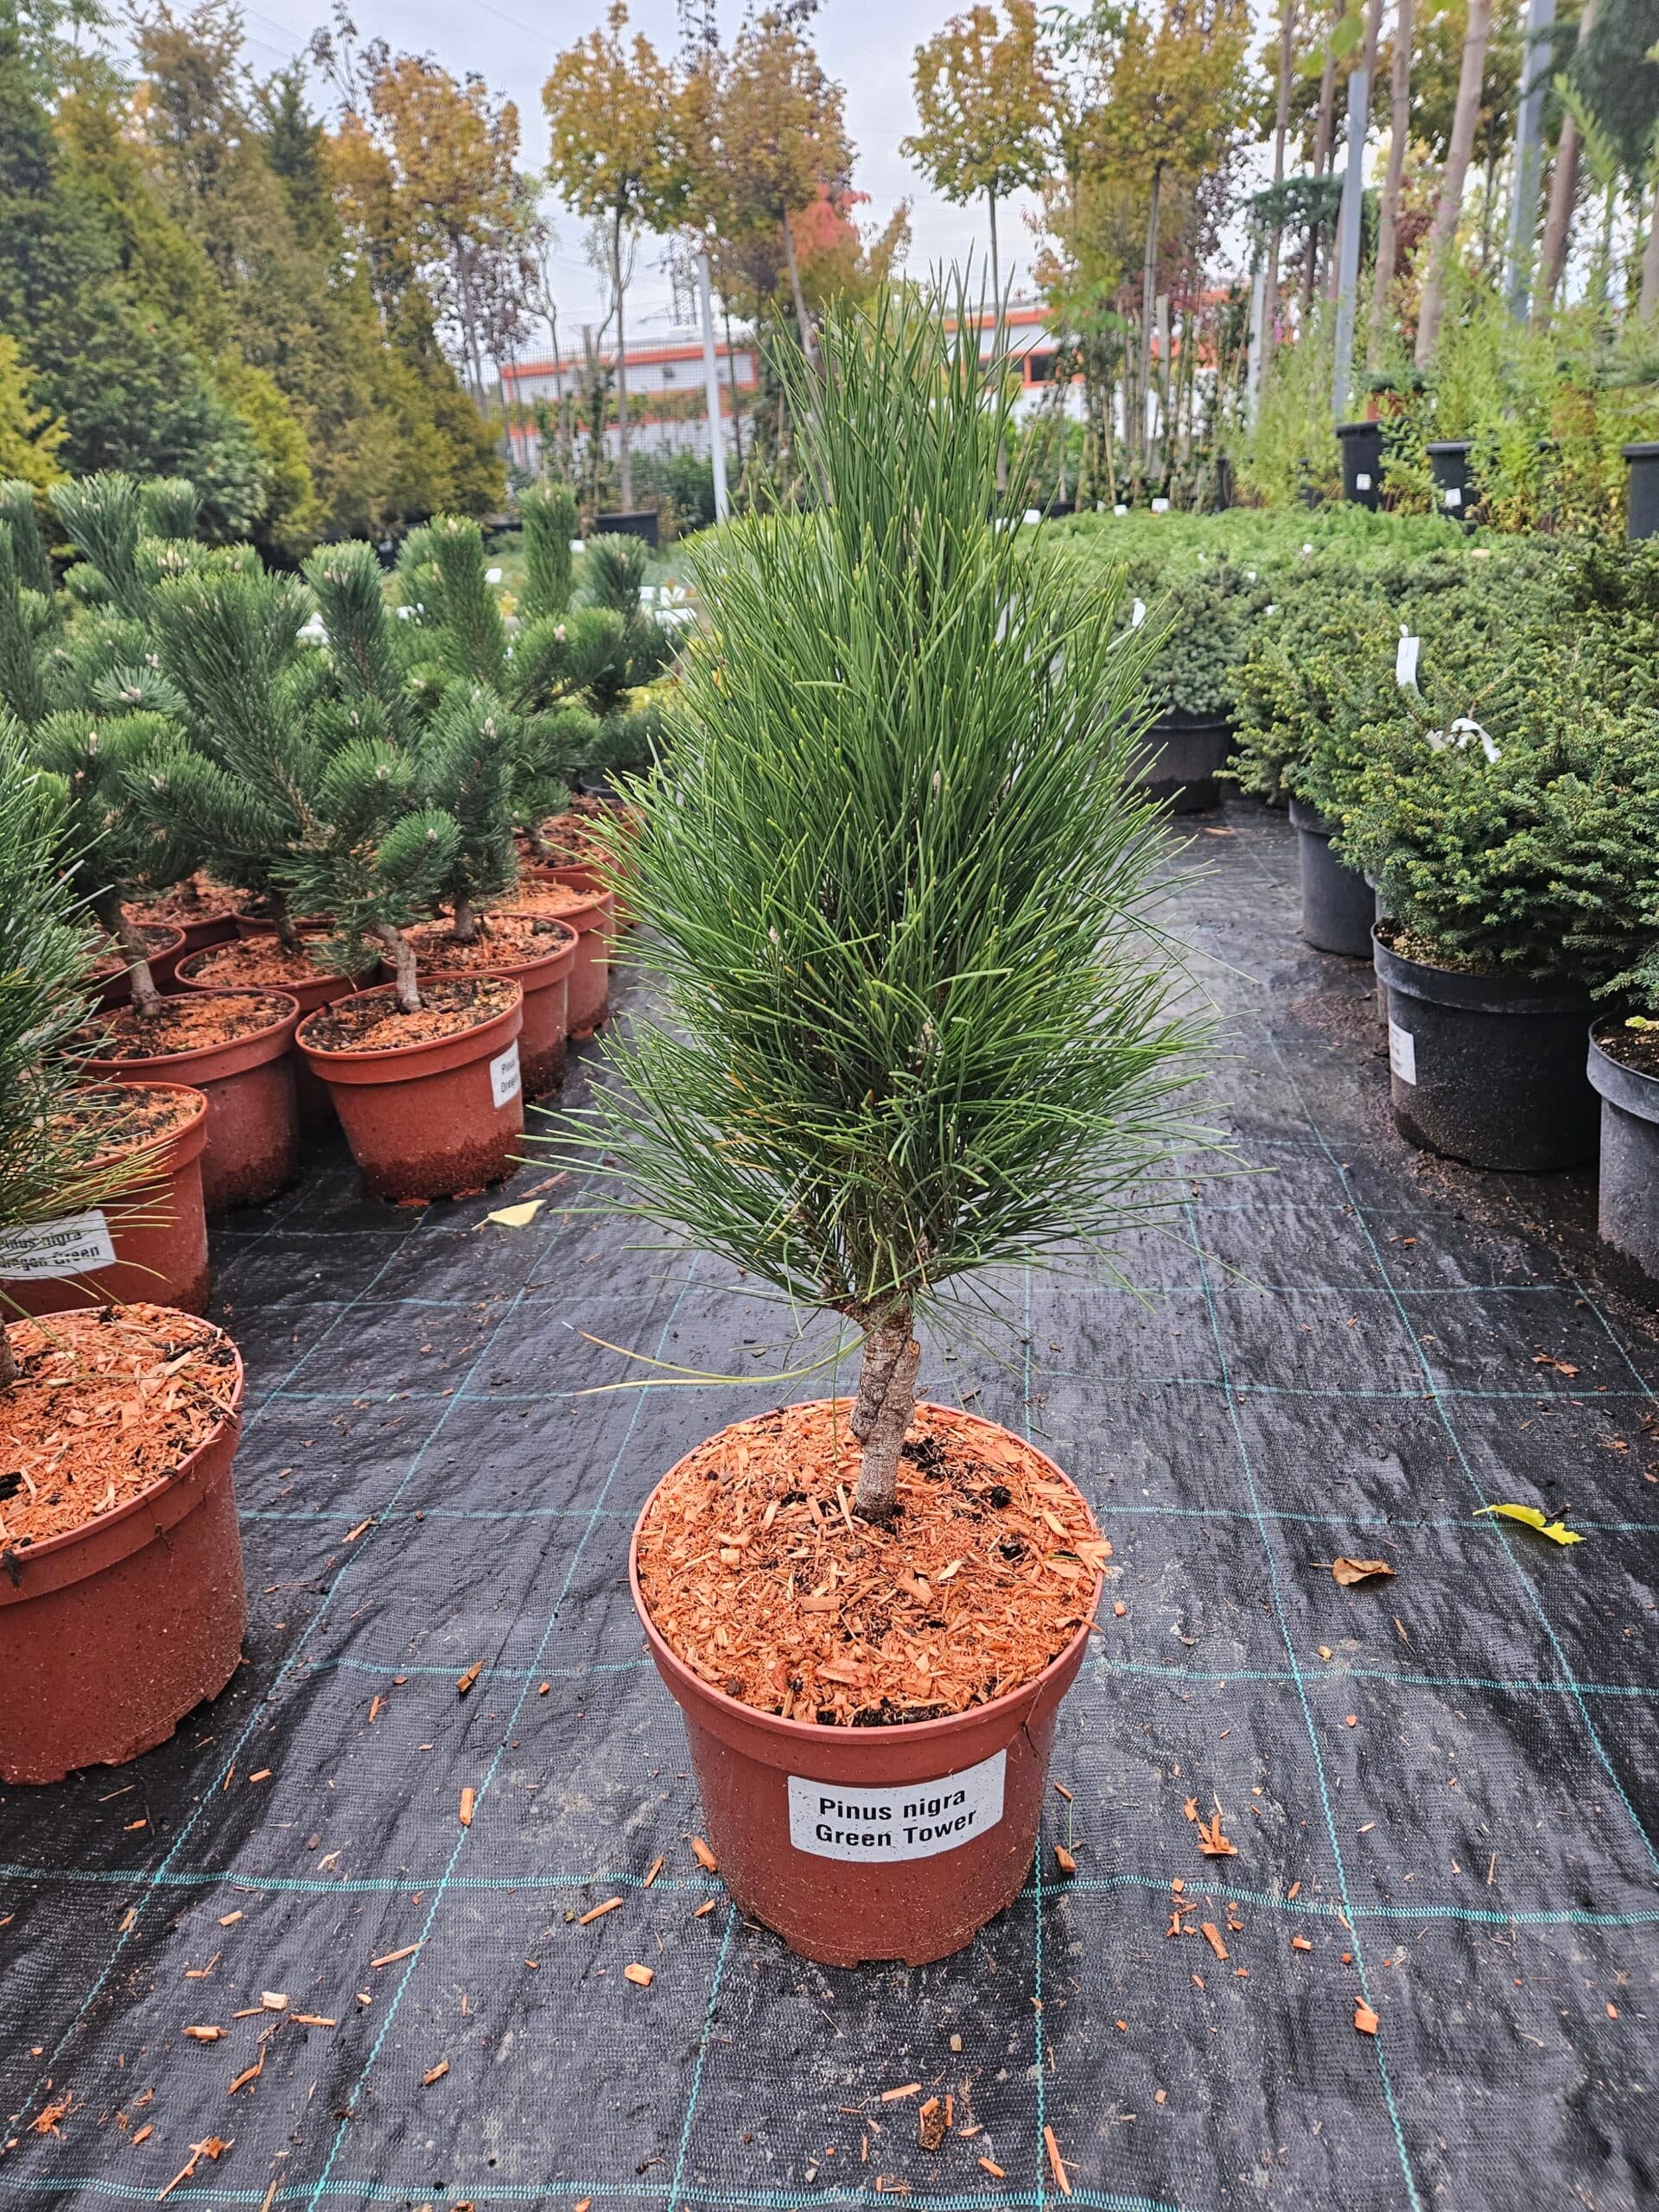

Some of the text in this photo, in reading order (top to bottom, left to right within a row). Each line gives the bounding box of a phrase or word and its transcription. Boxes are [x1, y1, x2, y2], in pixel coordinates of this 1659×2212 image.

[53, 1246, 100, 1265] Green
[819, 1789, 965, 1821] Pinus nigra
[816, 1810, 976, 1847] Green Tower
